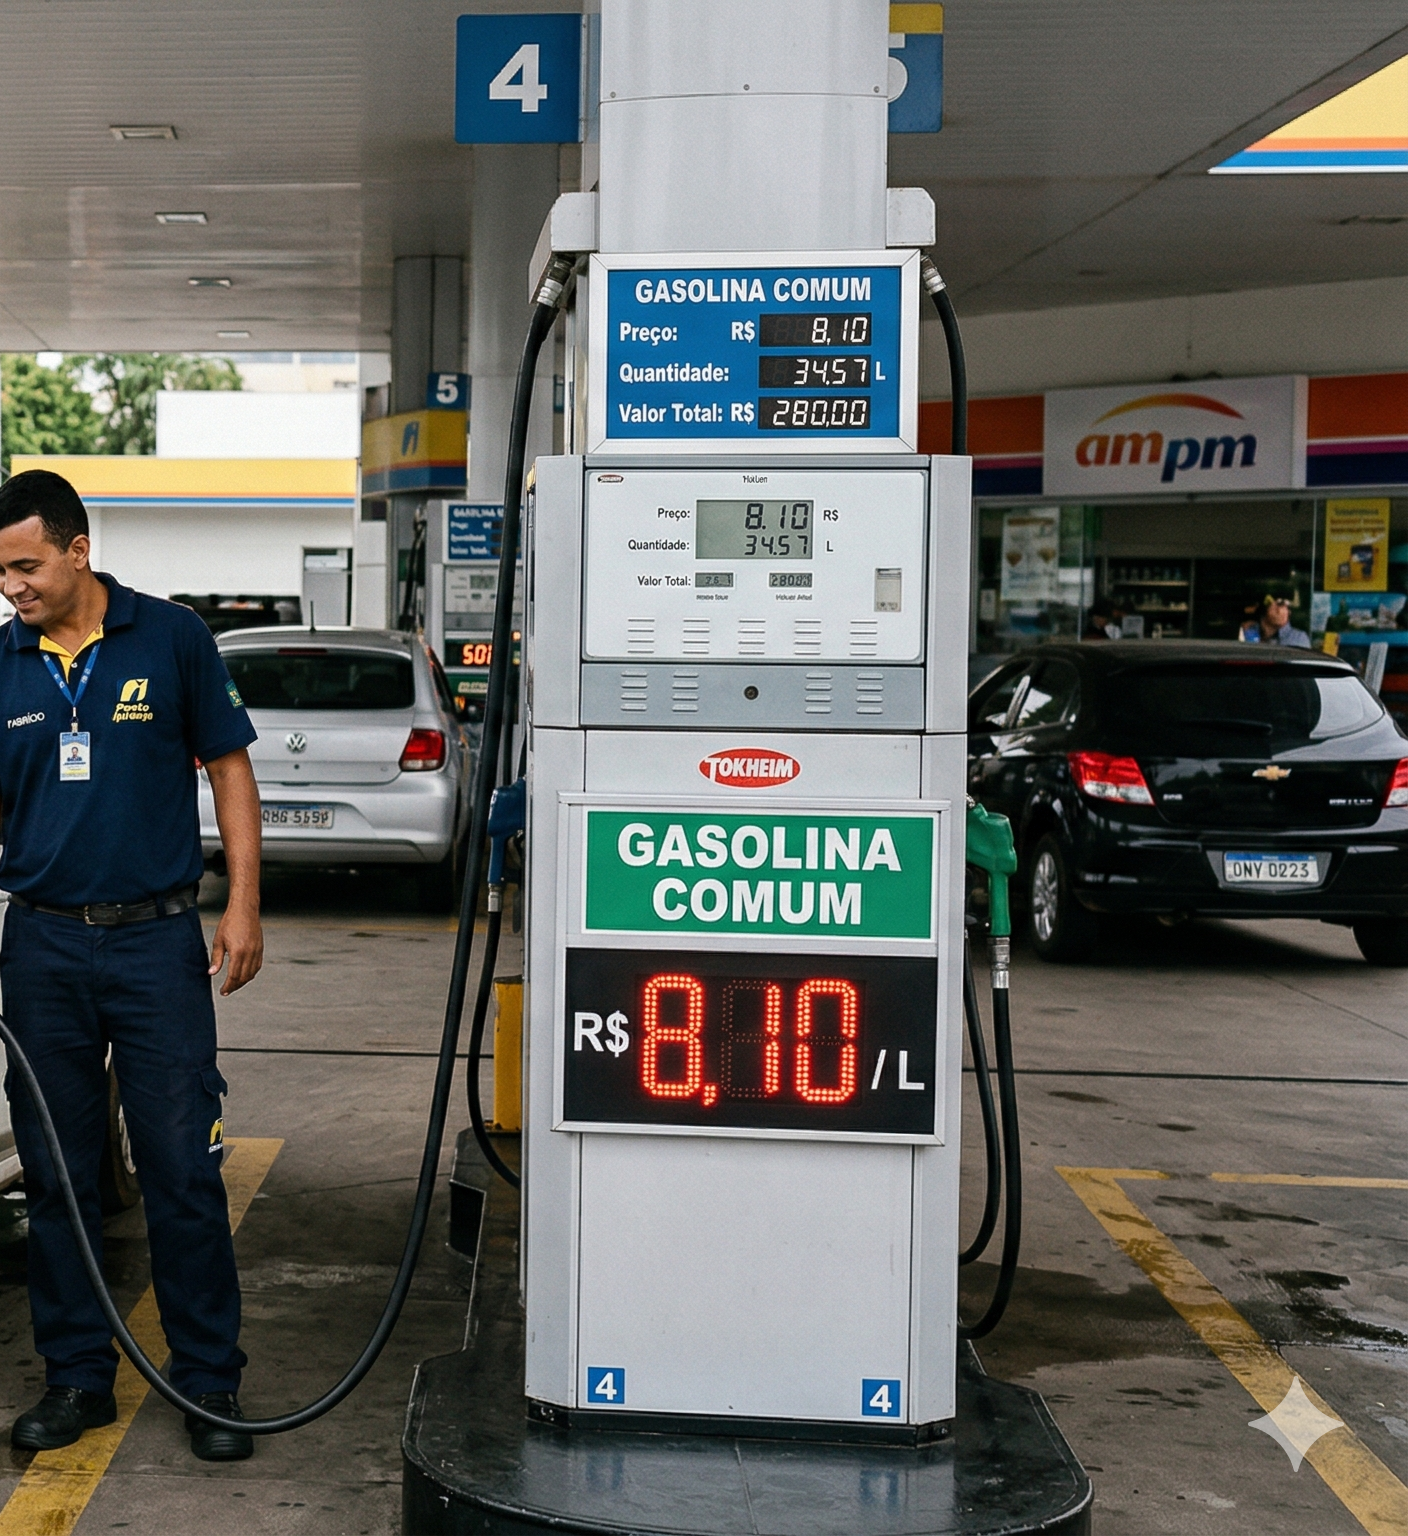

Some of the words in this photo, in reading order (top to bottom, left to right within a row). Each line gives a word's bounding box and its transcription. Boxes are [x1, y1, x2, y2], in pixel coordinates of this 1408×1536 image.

[489, 44, 548, 112] 4
[635, 278, 767, 303] GASOLINA
[773, 277, 872, 302] COMUM
[619, 322, 678, 345] Preço:
[731, 320, 755, 343] R$
[619, 363, 730, 384] Quantidade:
[875, 361, 886, 381] L
[435, 375, 459, 404] 5
[619, 403, 667, 423] Valor
[672, 403, 723, 423] Total:
[730, 402, 755, 425] R$
[772, 400, 867, 428] 280,00
[1075, 430, 1257, 483] ampm
[657, 508, 691, 520] Preço:
[744, 503, 809, 530] 8.10
[823, 509, 839, 522] R$
[628, 539, 690, 552] Quantidade:
[744, 535, 809, 556] 34.57
[826, 541, 834, 553] L
[637, 576, 662, 587] Valor
[665, 576, 691, 587] Total:
[703, 756, 793, 782] TOKHEIM
[617, 822, 902, 872] GASOLINA
[1233, 862, 1263, 878] ONY
[1269, 862, 1310, 878] 0223
[652, 877, 862, 925] COMUM
[573, 1009, 630, 1058] R$
[642, 973, 856, 1108] 8,10
[595, 1372, 617, 1400] 4
[869, 1385, 892, 1413] 4
